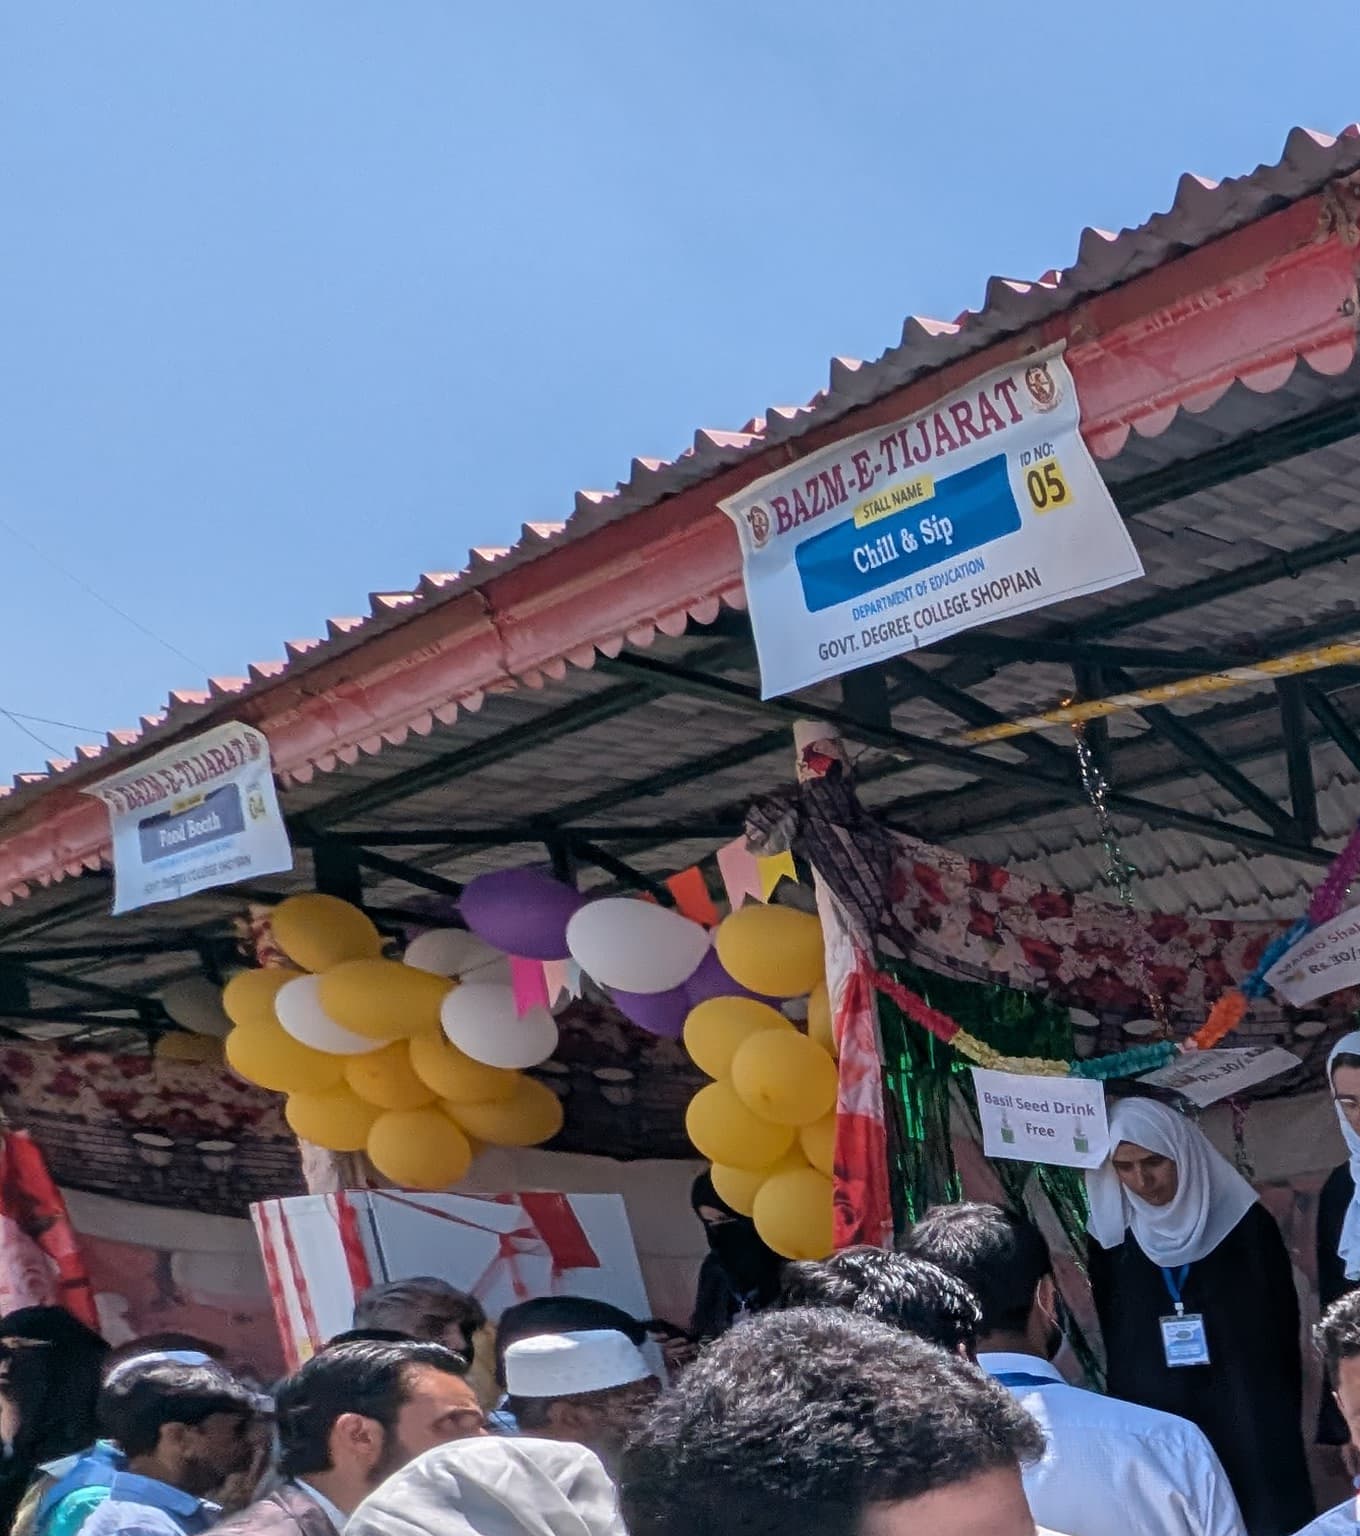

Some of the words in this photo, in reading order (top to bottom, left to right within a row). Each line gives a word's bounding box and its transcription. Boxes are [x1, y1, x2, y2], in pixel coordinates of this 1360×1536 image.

[771, 377, 1024, 535] BAZM-E-TIJARAT
[1019, 453, 1031, 467] ID
[1033, 443, 1055, 463] NO:
[863, 496, 893, 520] STALL
[893, 482, 923, 505] NAME
[1027, 463, 1065, 508] 05
[853, 533, 900, 574] Chill
[901, 528, 919, 553] &
[919, 514, 954, 546] Sip
[852, 585, 914, 622] DEPARTMENT
[915, 581, 928, 597] OF
[930, 557, 986, 592] EDUCATION
[818, 636, 860, 661] GOVT.
[862, 615, 914, 649] DEGREE
[913, 598, 972, 630] COLLEGE
[971, 567, 1042, 609] SHOPIAN
[984, 1092, 1014, 1108] Basil
[1016, 1097, 1050, 1113] Seed
[1053, 1101, 1096, 1117] Drink
[1025, 1122, 1056, 1138] Free
